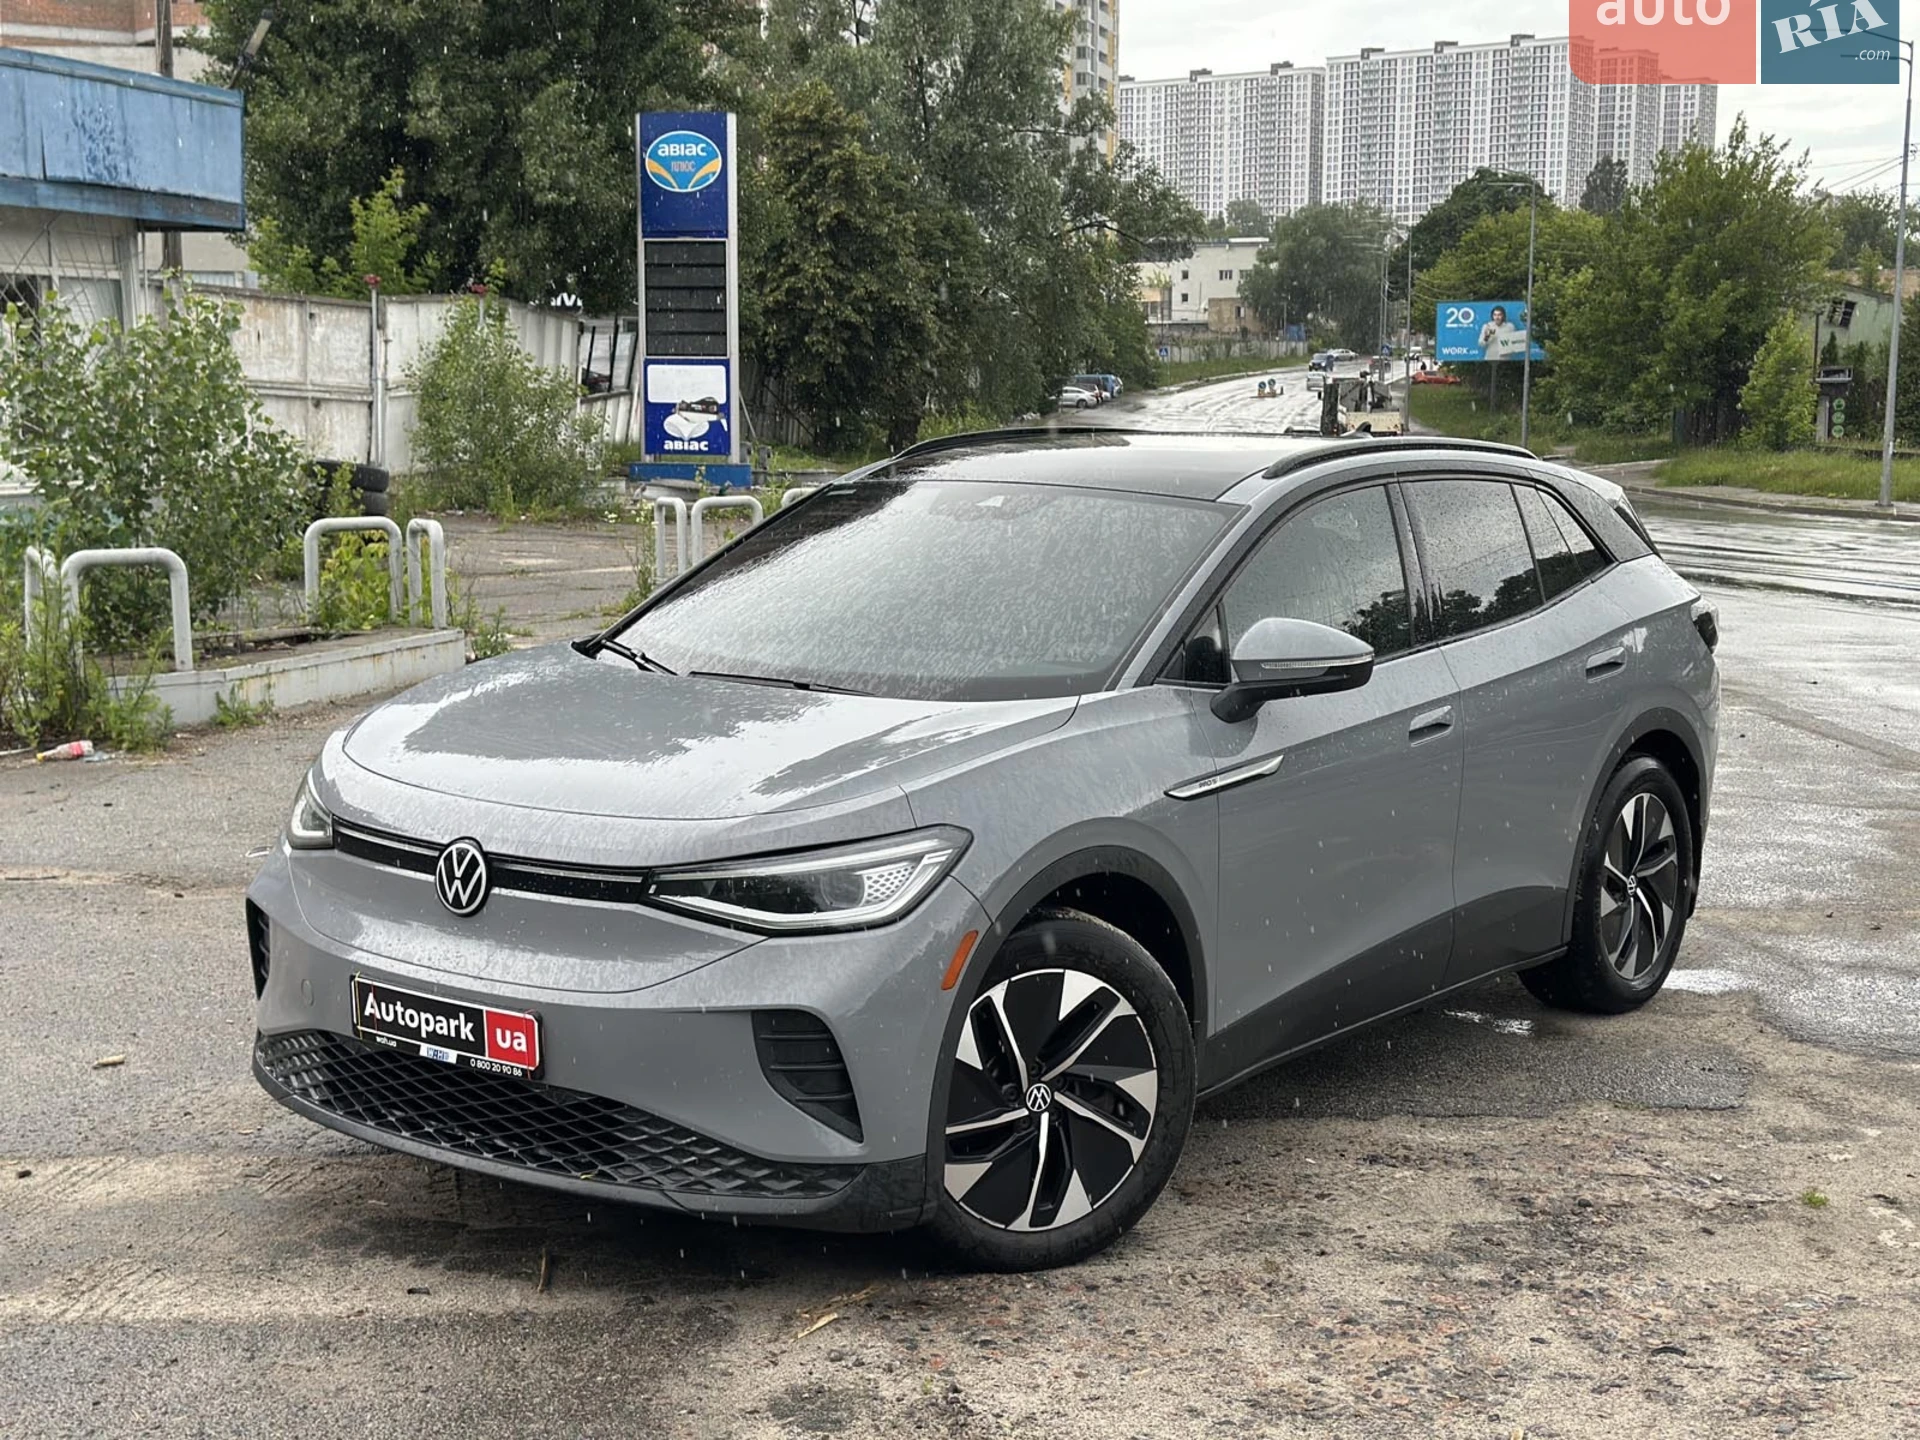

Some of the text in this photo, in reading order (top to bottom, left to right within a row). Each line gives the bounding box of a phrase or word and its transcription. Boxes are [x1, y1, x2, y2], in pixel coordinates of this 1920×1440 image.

[1445, 307, 1475, 328] 20
[363, 992, 528, 1052] Autopark ua
[470, 1058, 476, 1067] 0
[476, 1060, 491, 1070] 800
[491, 1063, 501, 1072] 20
[502, 1065, 512, 1075] 90
